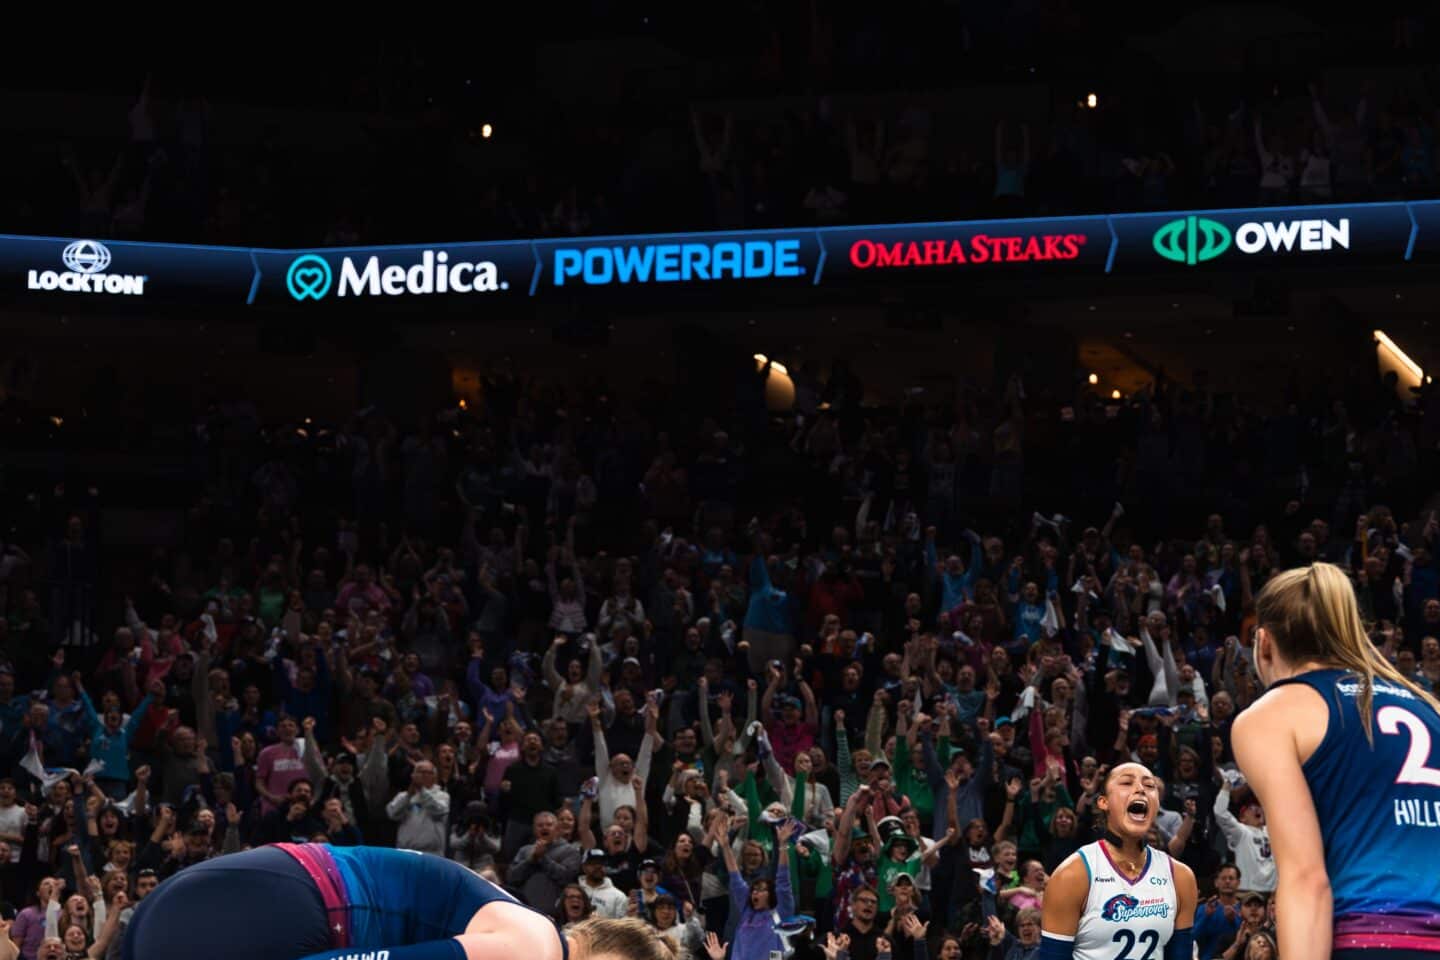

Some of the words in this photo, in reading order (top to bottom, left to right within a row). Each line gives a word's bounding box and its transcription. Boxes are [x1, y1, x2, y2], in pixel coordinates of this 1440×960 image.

[1235, 218, 1350, 254] OWEN
[554, 239, 801, 286] POWERADE
[849, 239, 967, 268] OMAHA
[28, 269, 145, 295] LOCKTON
